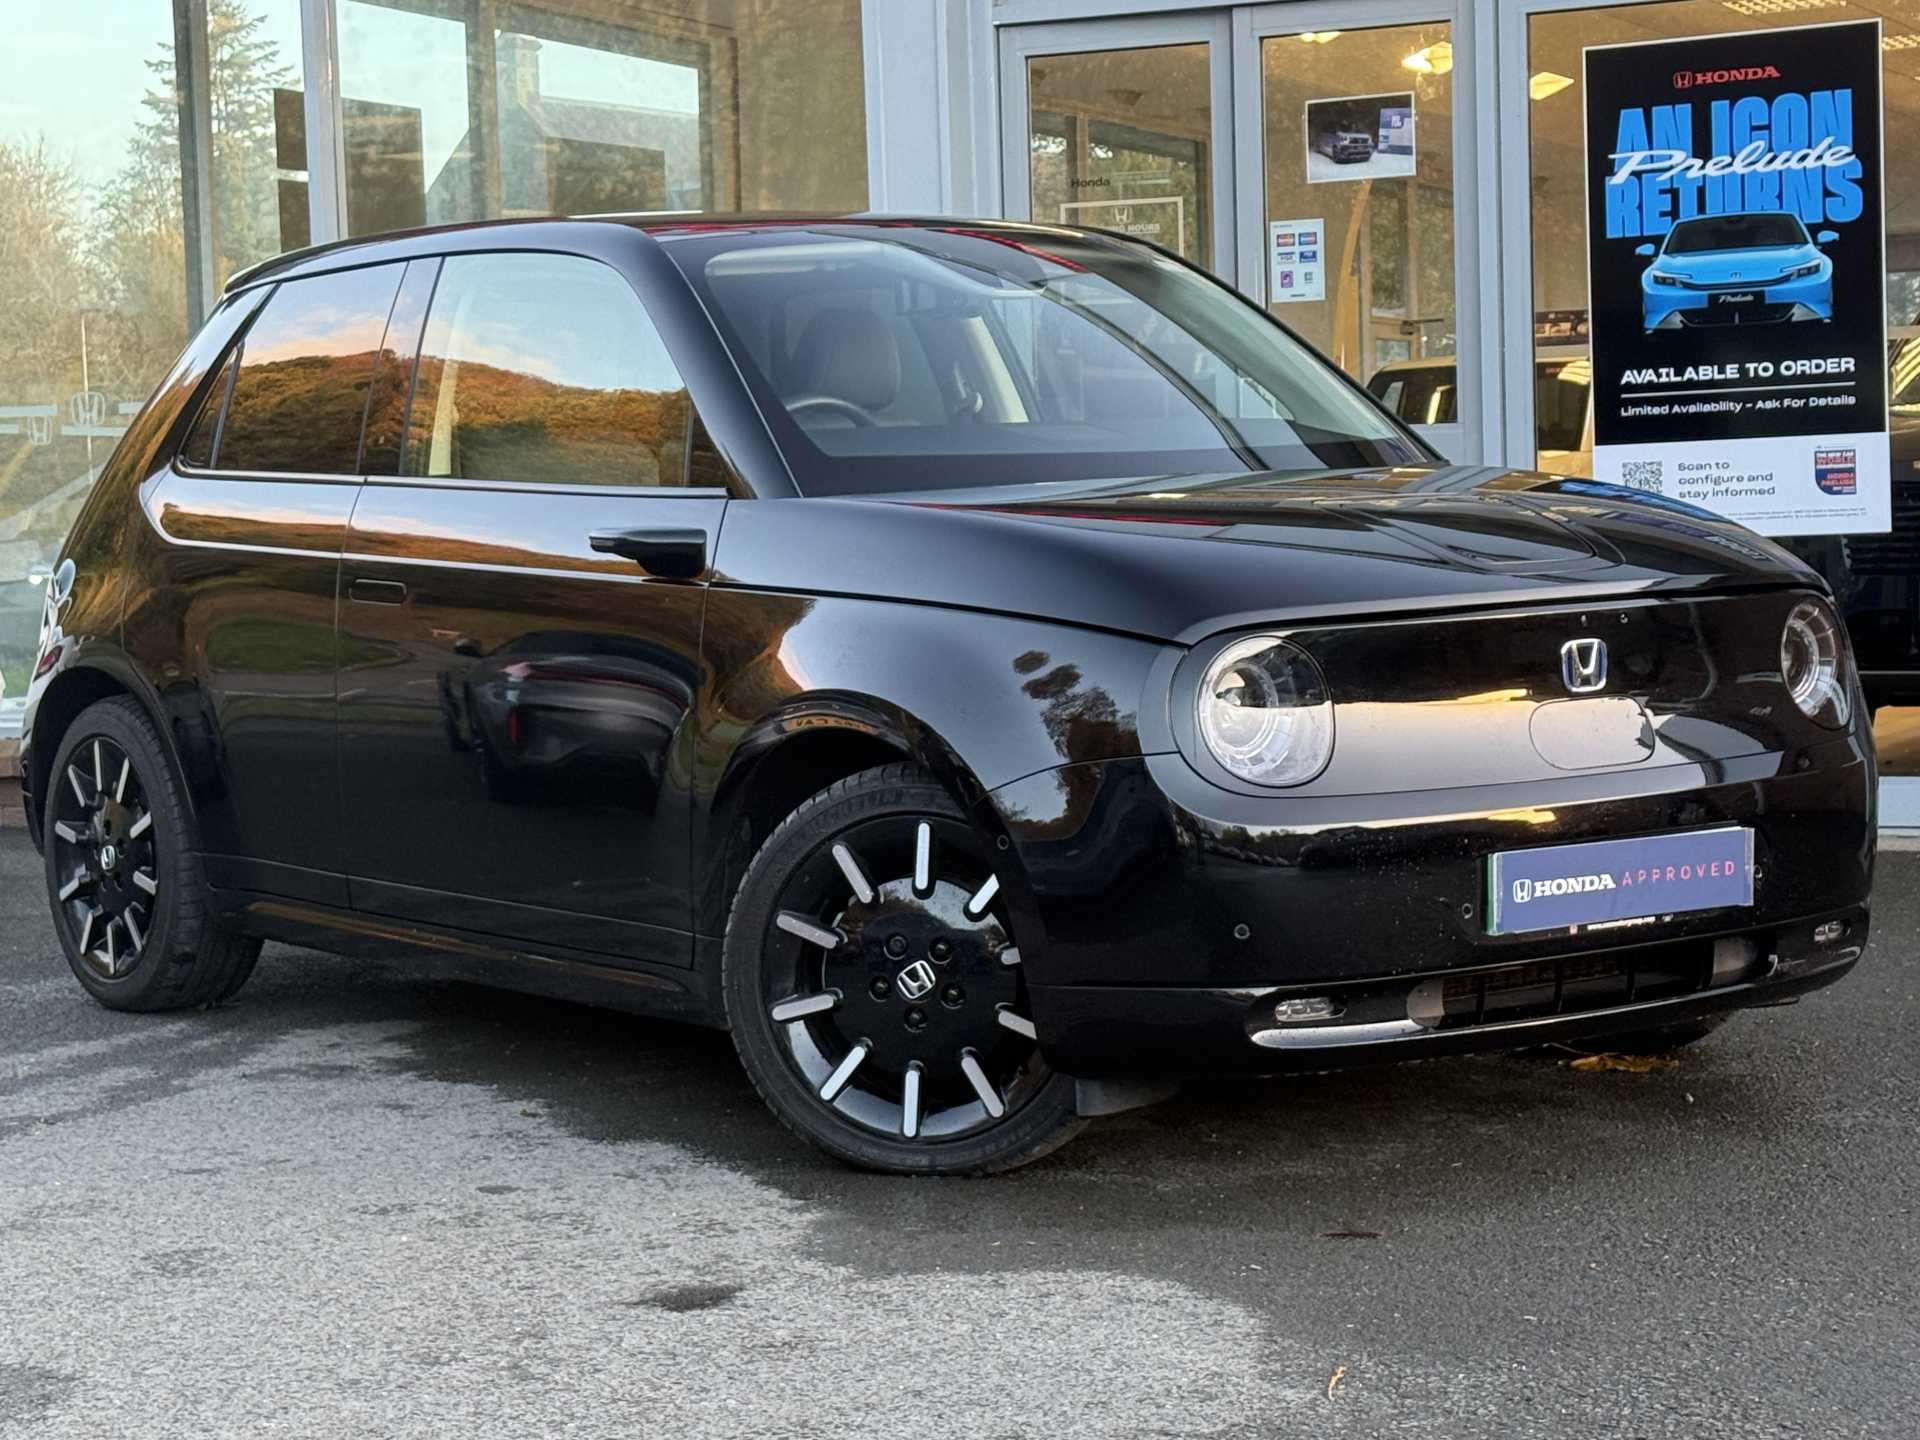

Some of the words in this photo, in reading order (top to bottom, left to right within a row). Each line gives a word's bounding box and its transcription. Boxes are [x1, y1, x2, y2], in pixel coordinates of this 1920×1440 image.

[1695, 66, 1781, 85] HONDA
[1614, 103, 1692, 173] AN
[1711, 88, 1853, 160] ICON
[1608, 136, 1856, 185] Prelude
[1070, 176, 1110, 188] Honda
[1605, 157, 1863, 239] RETURNS
[1620, 363, 1740, 385] AVAILABLE
[1745, 361, 1774, 378] TO
[1780, 357, 1856, 377] ORDER
[1621, 404, 1669, 417] Limited
[1672, 401, 1743, 414] Availability
[1755, 398, 1781, 410] Ask
[1783, 397, 1806, 409] For
[1809, 395, 1856, 407] Details
[1678, 462, 1712, 472] Scan
[1715, 461, 1730, 470] to
[1678, 474, 1744, 486] configure
[1747, 472, 1774, 482] and
[1679, 490, 1709, 500] stay
[1712, 486, 1776, 497] informed
[1534, 873, 1616, 898] HONDA
[1621, 860, 1736, 888] APPROVED
